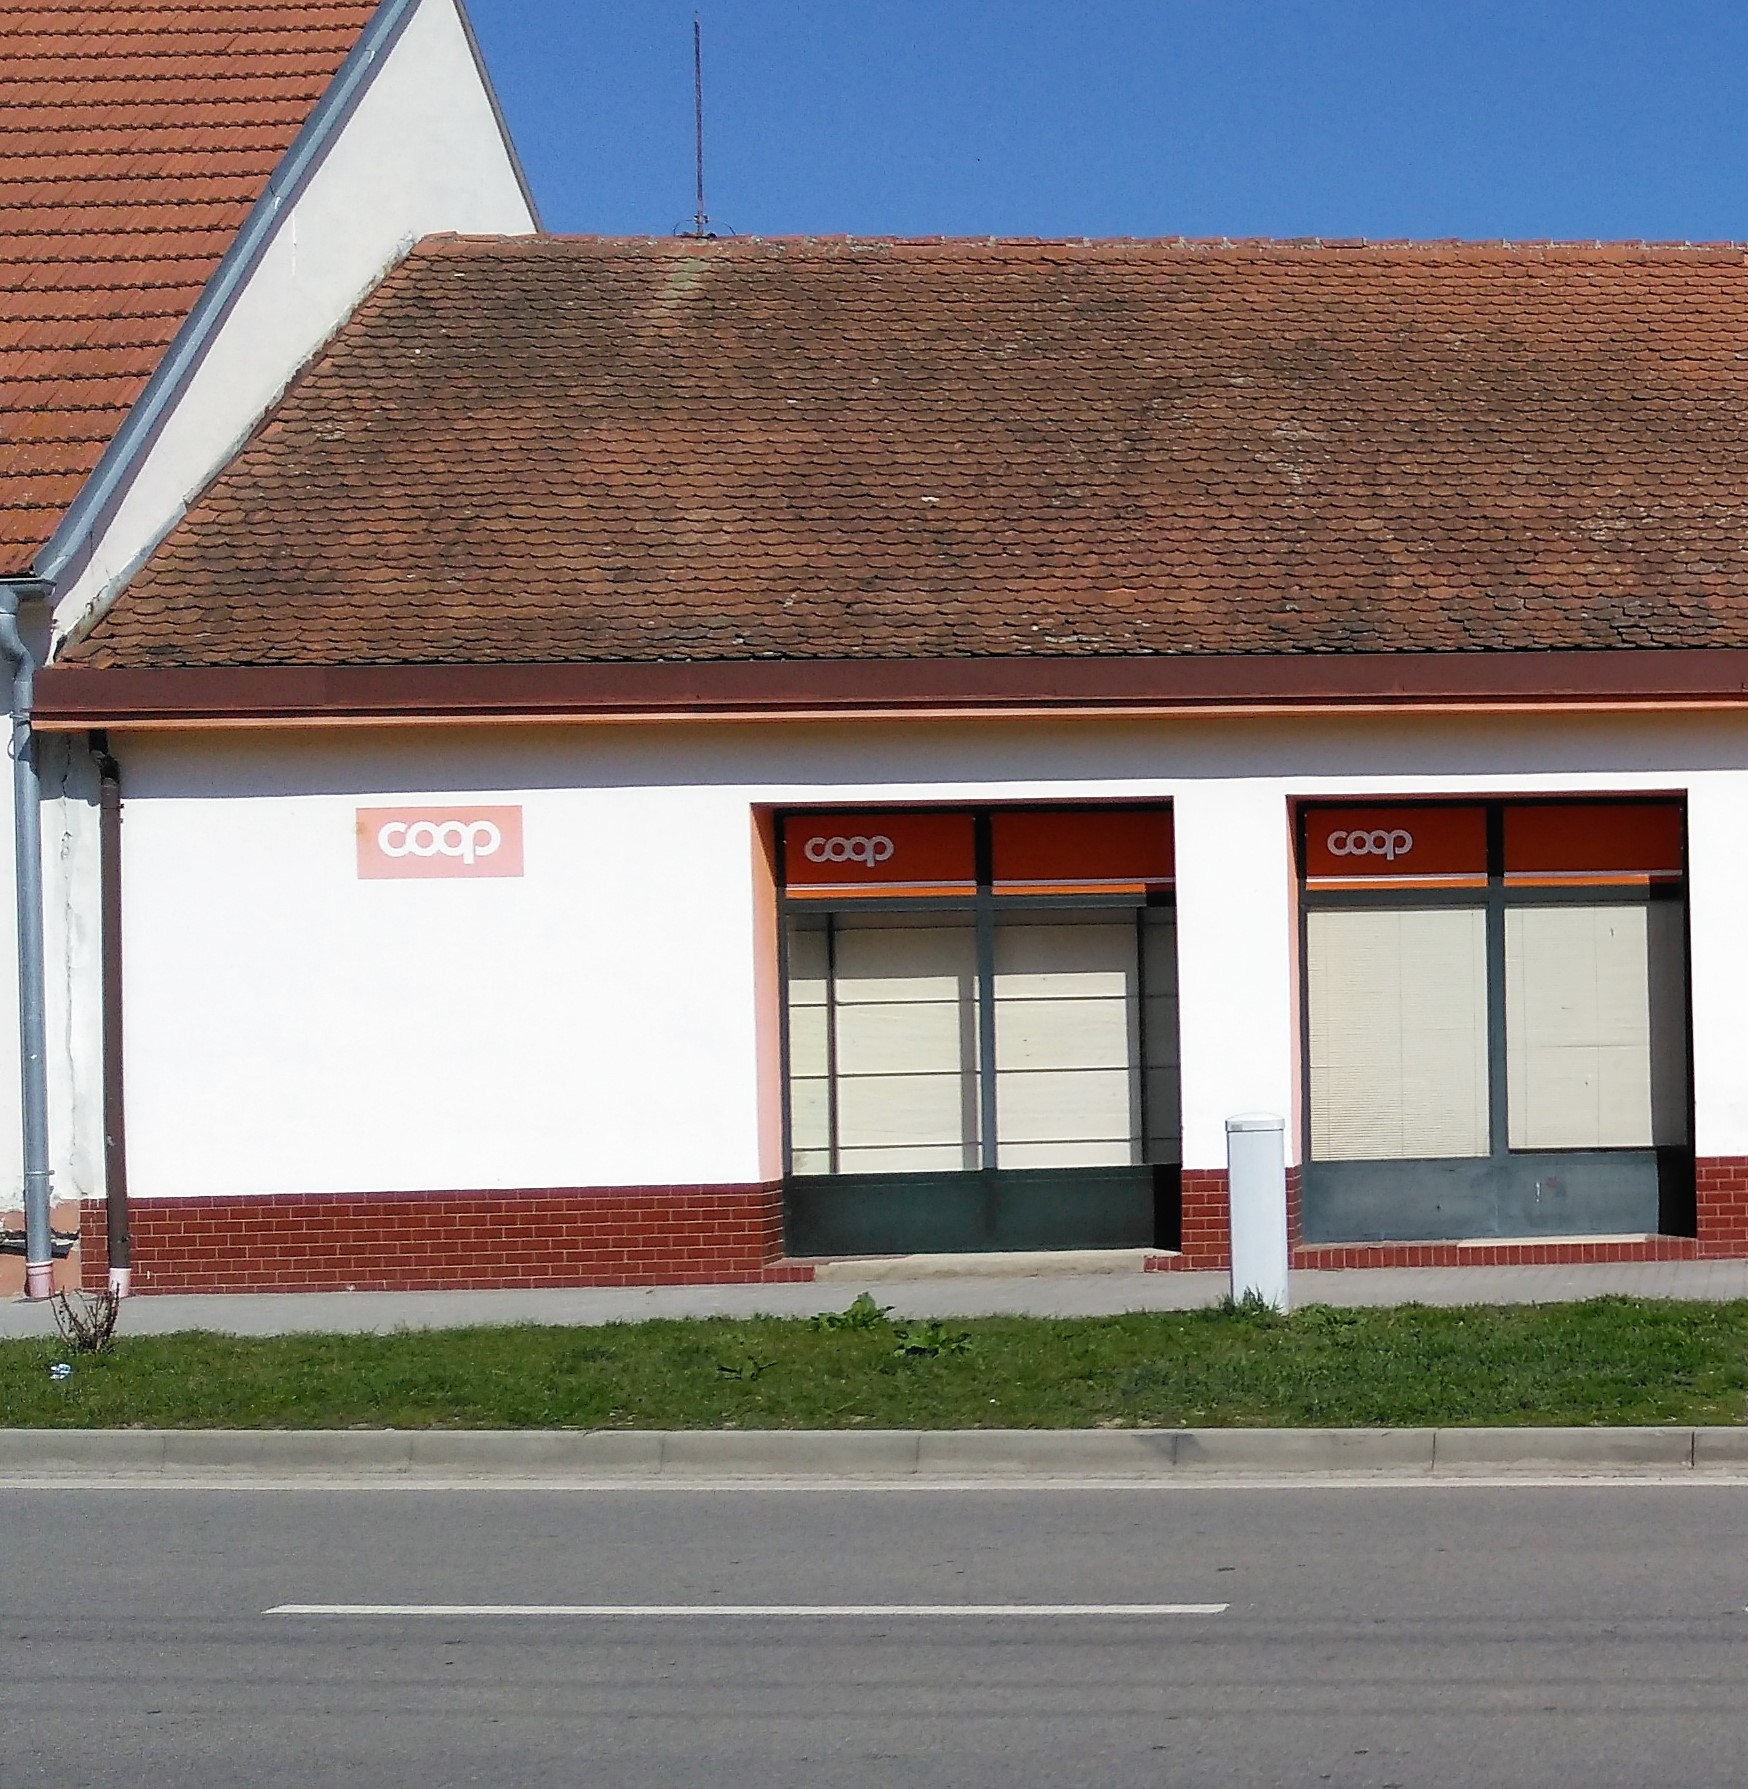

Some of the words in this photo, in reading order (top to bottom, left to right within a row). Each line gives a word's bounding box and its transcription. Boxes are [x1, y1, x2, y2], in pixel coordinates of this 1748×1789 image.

[378, 821, 500, 864] coop
[806, 836, 893, 867] coop
[1328, 830, 1412, 860] coop
